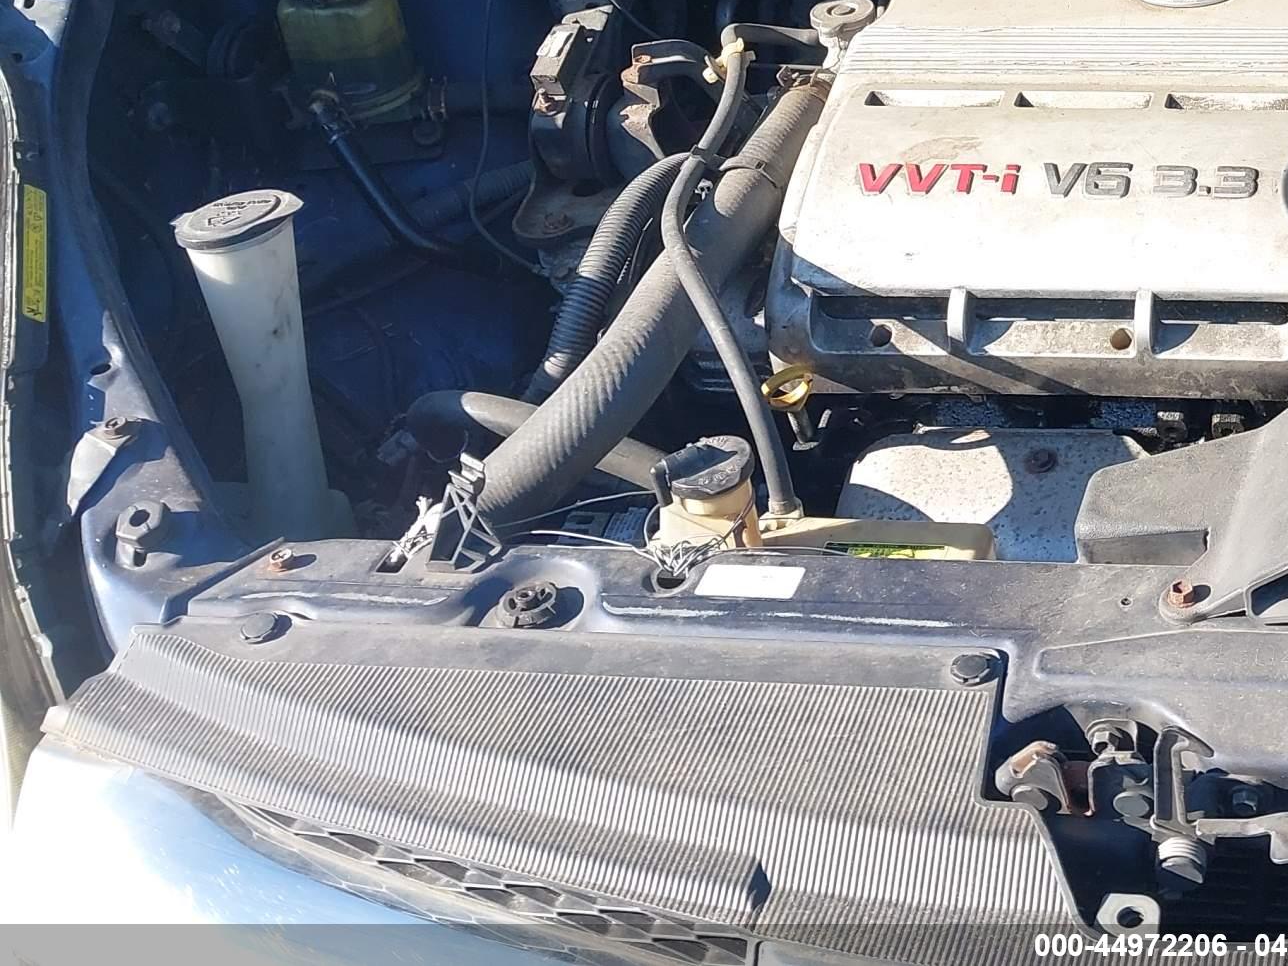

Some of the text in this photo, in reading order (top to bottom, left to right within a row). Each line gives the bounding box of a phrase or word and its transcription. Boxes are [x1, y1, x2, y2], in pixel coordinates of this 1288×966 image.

[858, 161, 1260, 199] VVT-i V6 3.3
